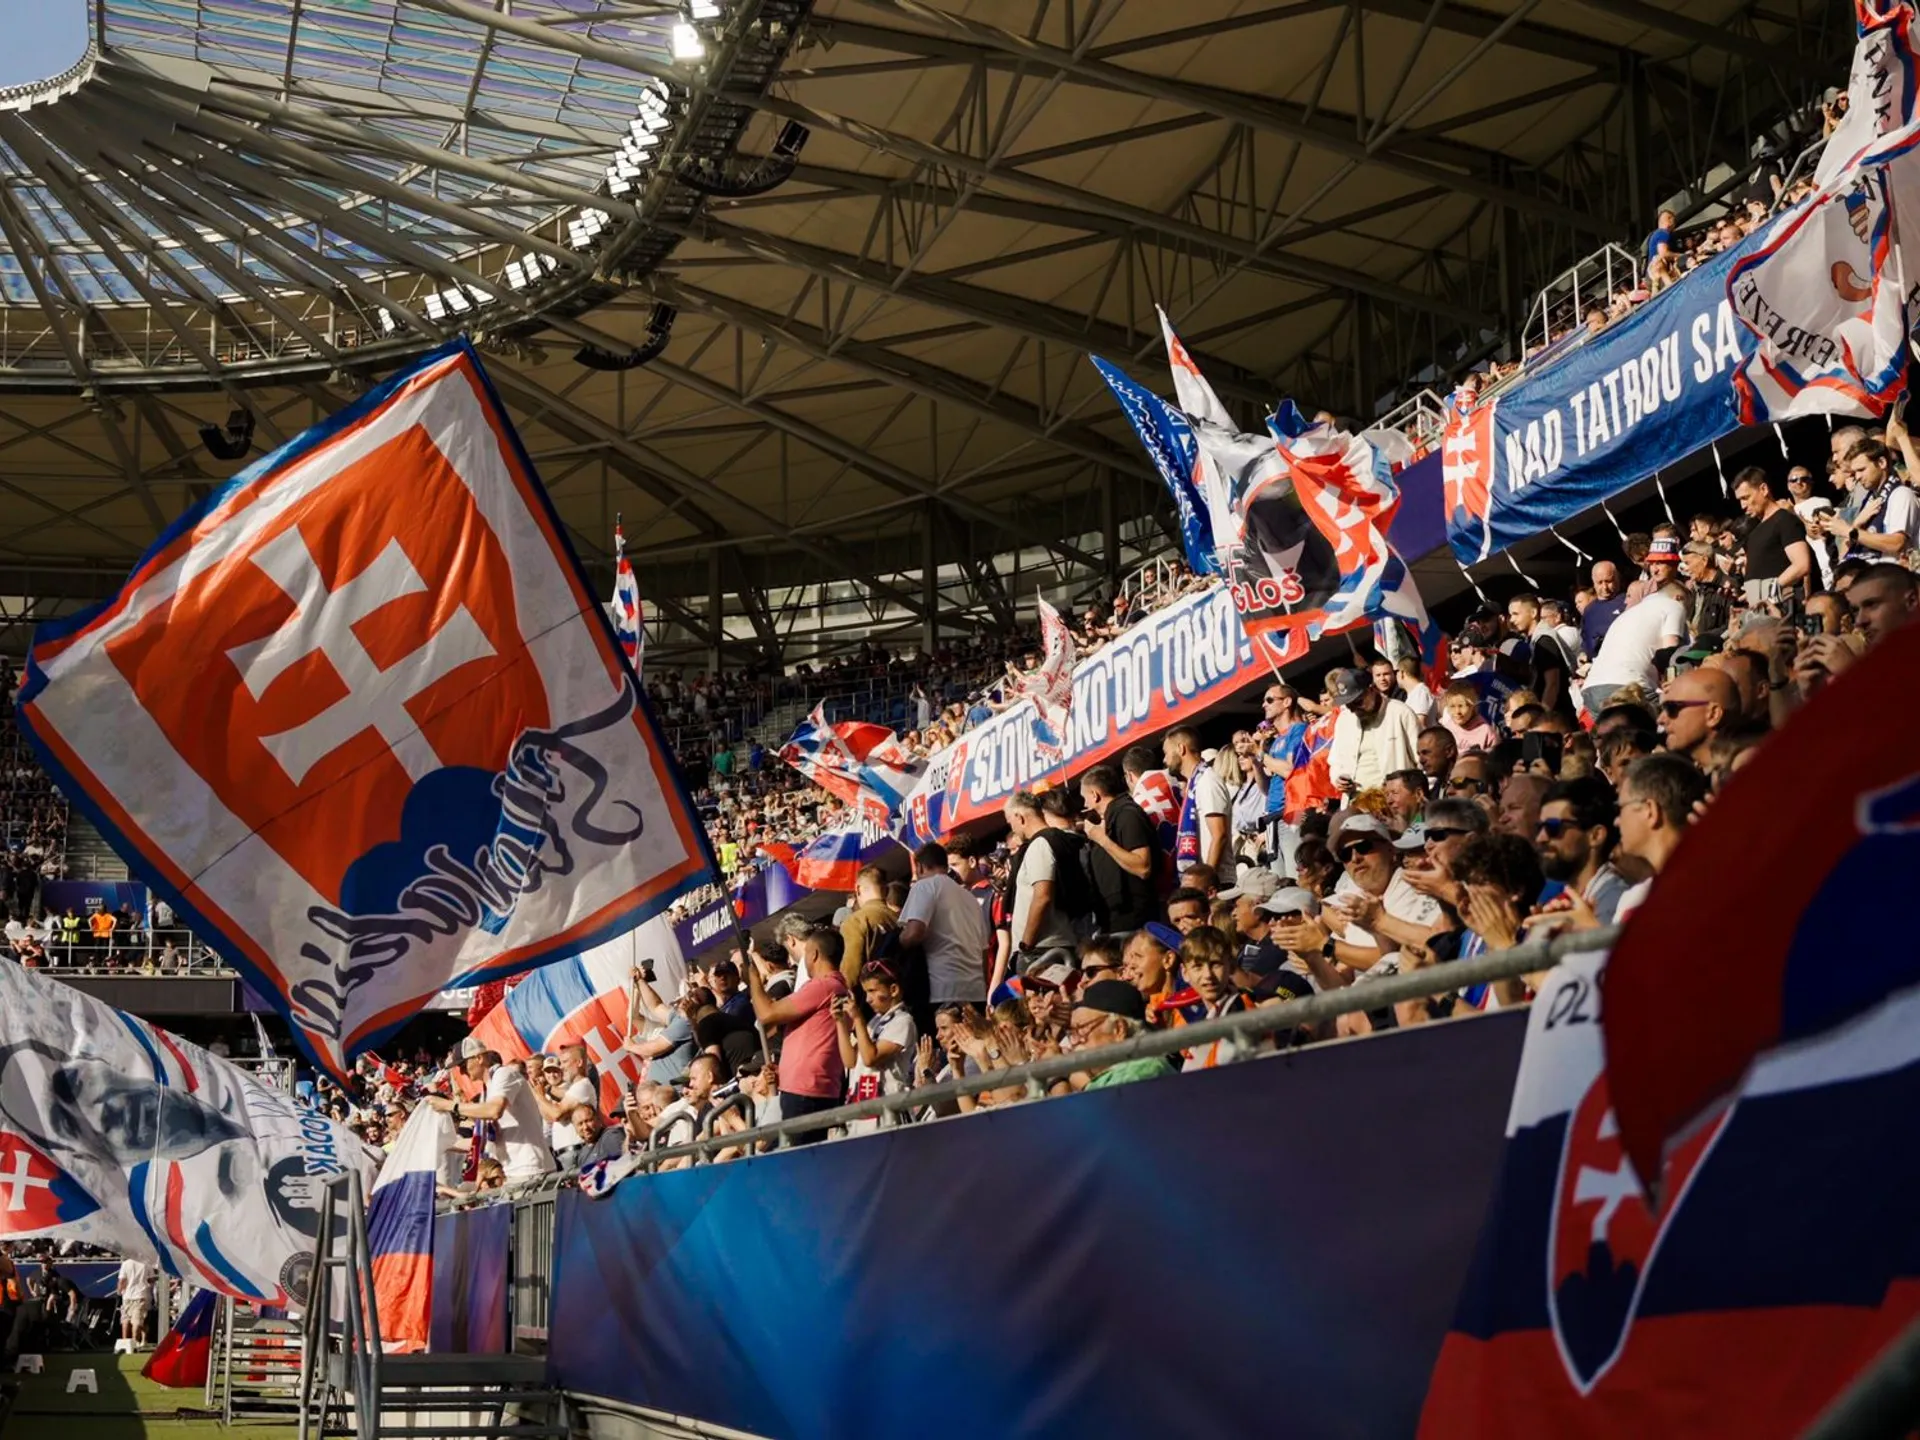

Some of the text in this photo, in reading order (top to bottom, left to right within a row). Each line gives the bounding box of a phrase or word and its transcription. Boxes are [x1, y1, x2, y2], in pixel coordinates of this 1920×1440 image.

[1504, 408, 1564, 493] NAD
[1570, 330, 1682, 457] TATROU
[1691, 297, 1743, 384] SA
[1113, 637, 1152, 732] DO
[1160, 590, 1256, 708] TOHO!
[85, 897, 103, 905] EXIT
[692, 904, 732, 946] SLOVAKIA 202
[440, 986, 479, 999] UEF
